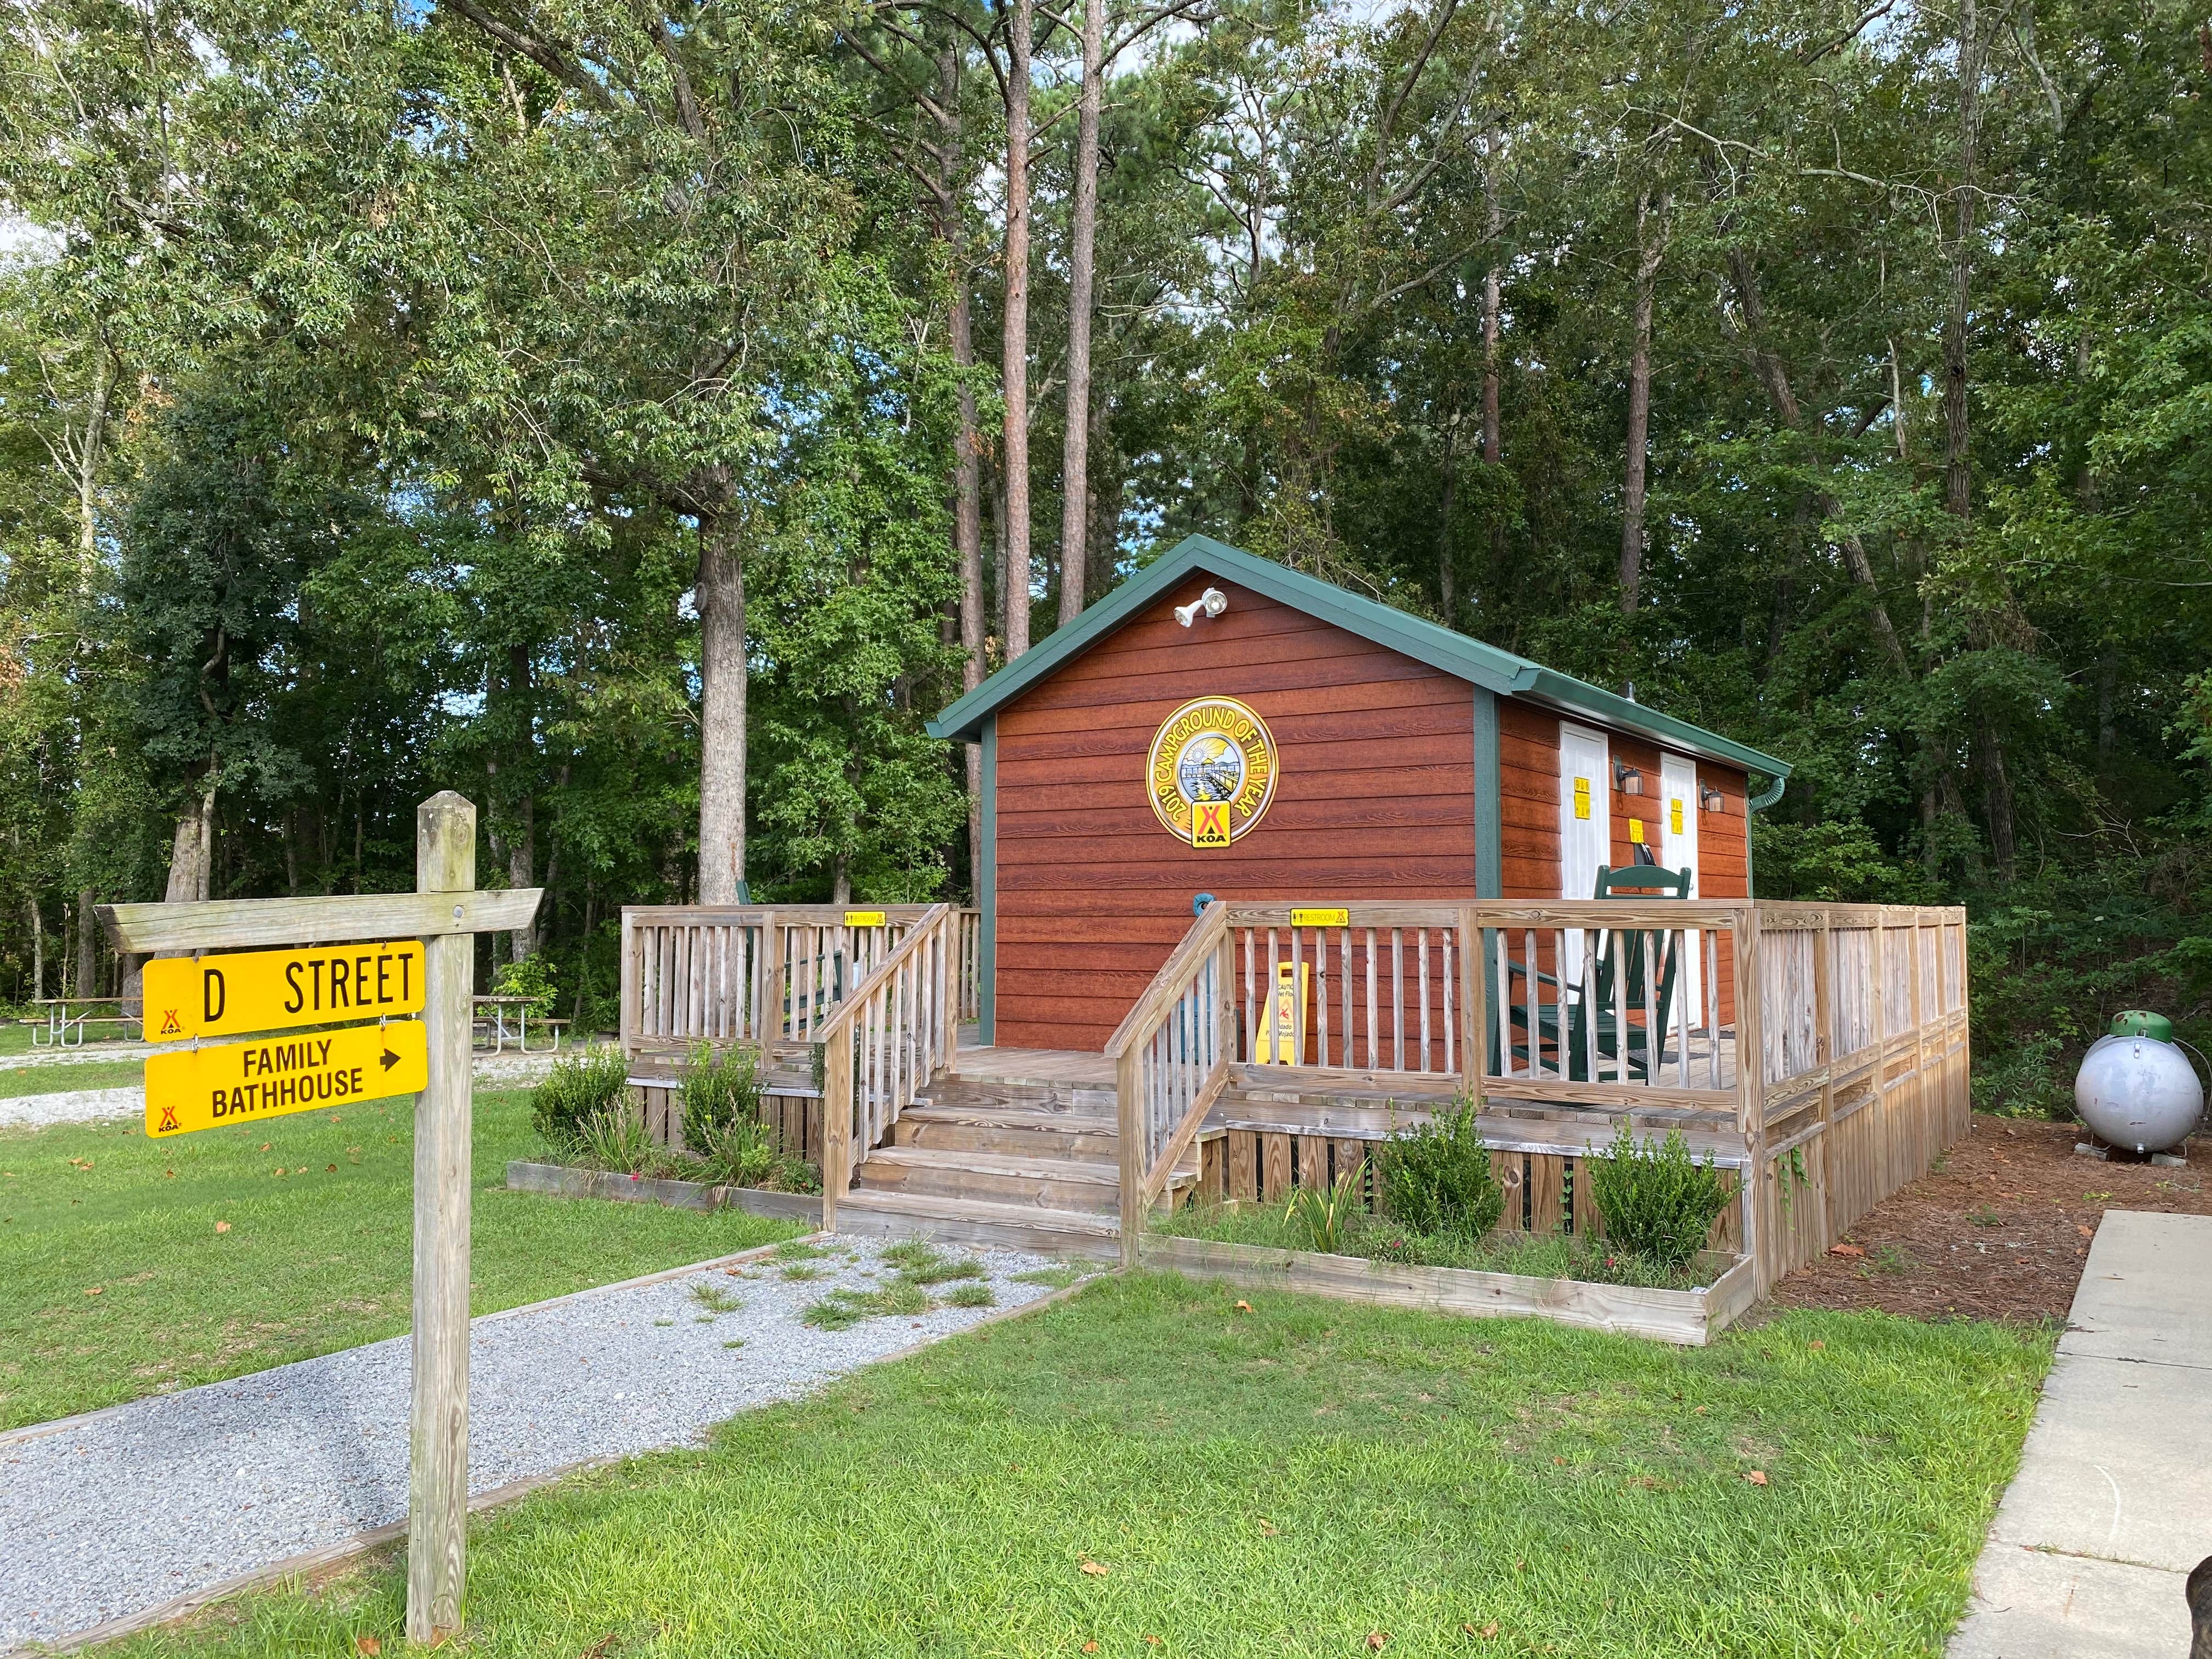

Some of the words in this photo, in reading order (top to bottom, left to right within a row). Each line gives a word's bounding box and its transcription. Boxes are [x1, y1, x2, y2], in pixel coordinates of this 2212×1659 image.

[1155, 707, 1236, 782] CAMPGROUND
[1234, 719, 1258, 743] OF
[1246, 739, 1268, 775] THE
[1158, 785, 1187, 821] 2019
[1234, 777, 1267, 817] YEAR
[1197, 834, 1227, 843] KOA
[204, 968, 225, 1023] D
[284, 953, 413, 1013] STREET
[243, 1039, 332, 1077] FAMILY
[212, 1068, 363, 1118] BATHHOUSE
